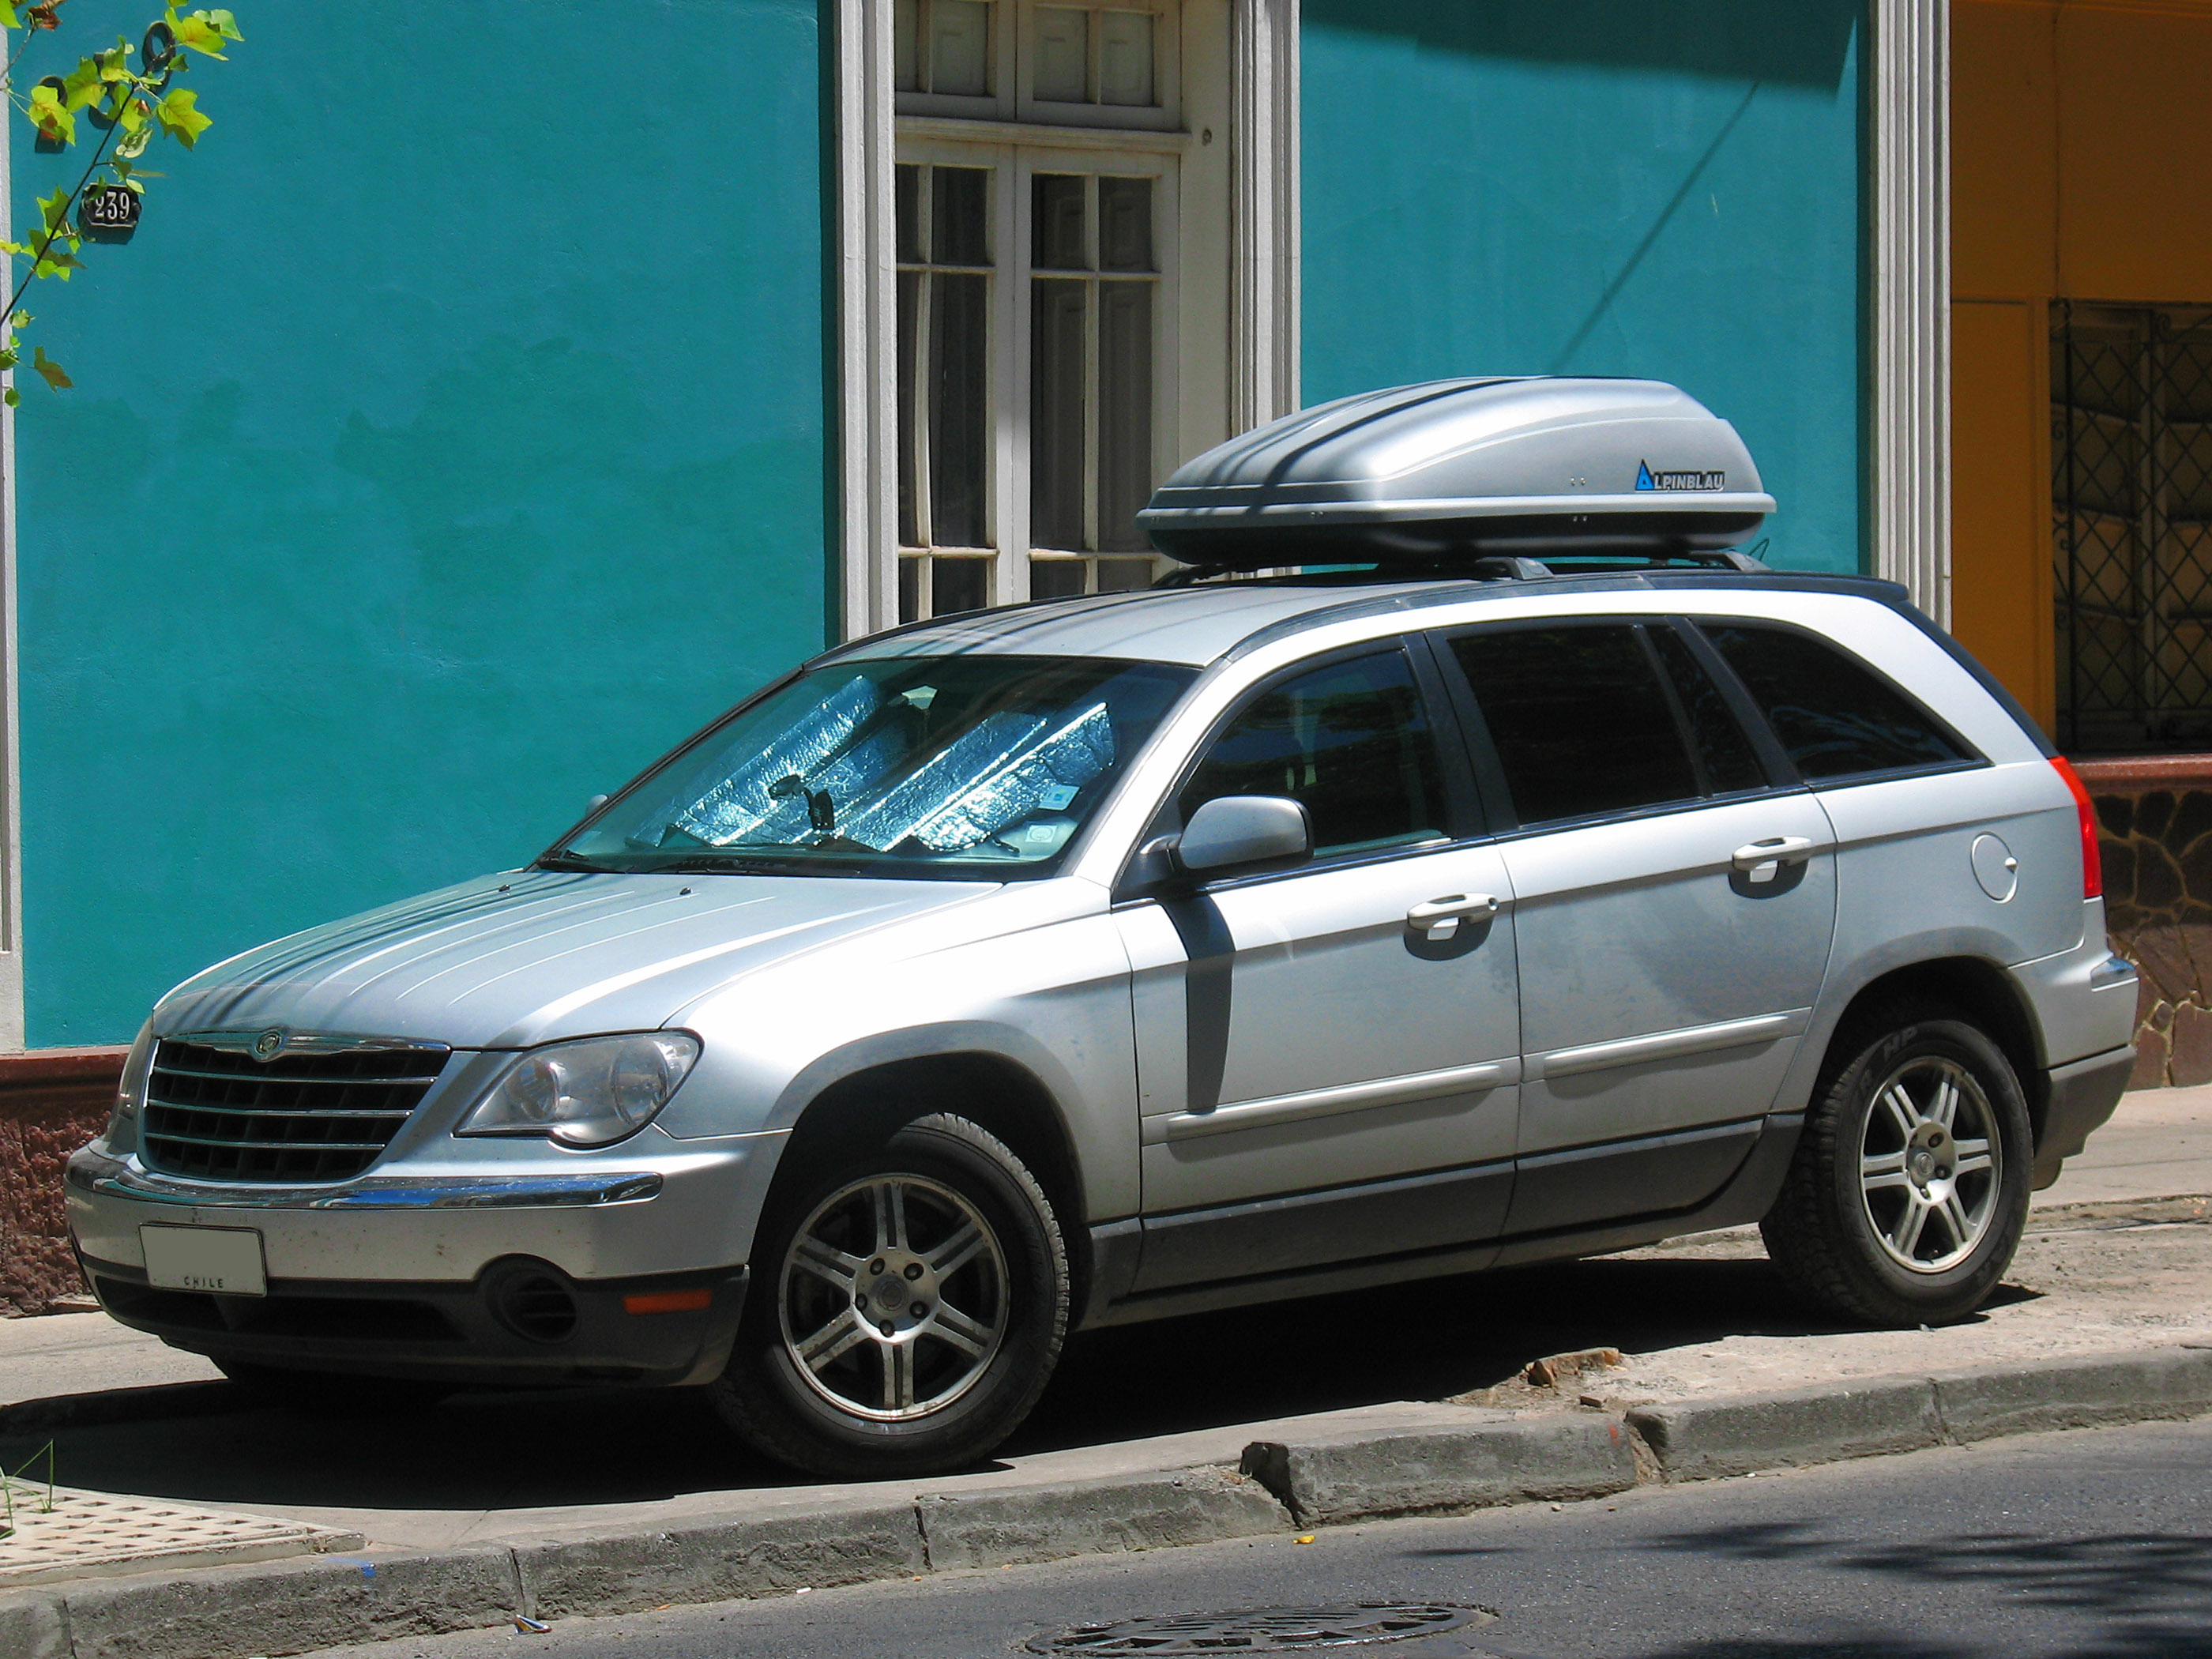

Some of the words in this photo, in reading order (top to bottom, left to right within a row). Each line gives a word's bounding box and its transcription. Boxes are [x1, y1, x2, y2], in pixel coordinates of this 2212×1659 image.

[95, 190, 130, 220] 239
[1635, 458, 1725, 491] ALPINBLAU
[183, 1276, 224, 1288] CHILE
